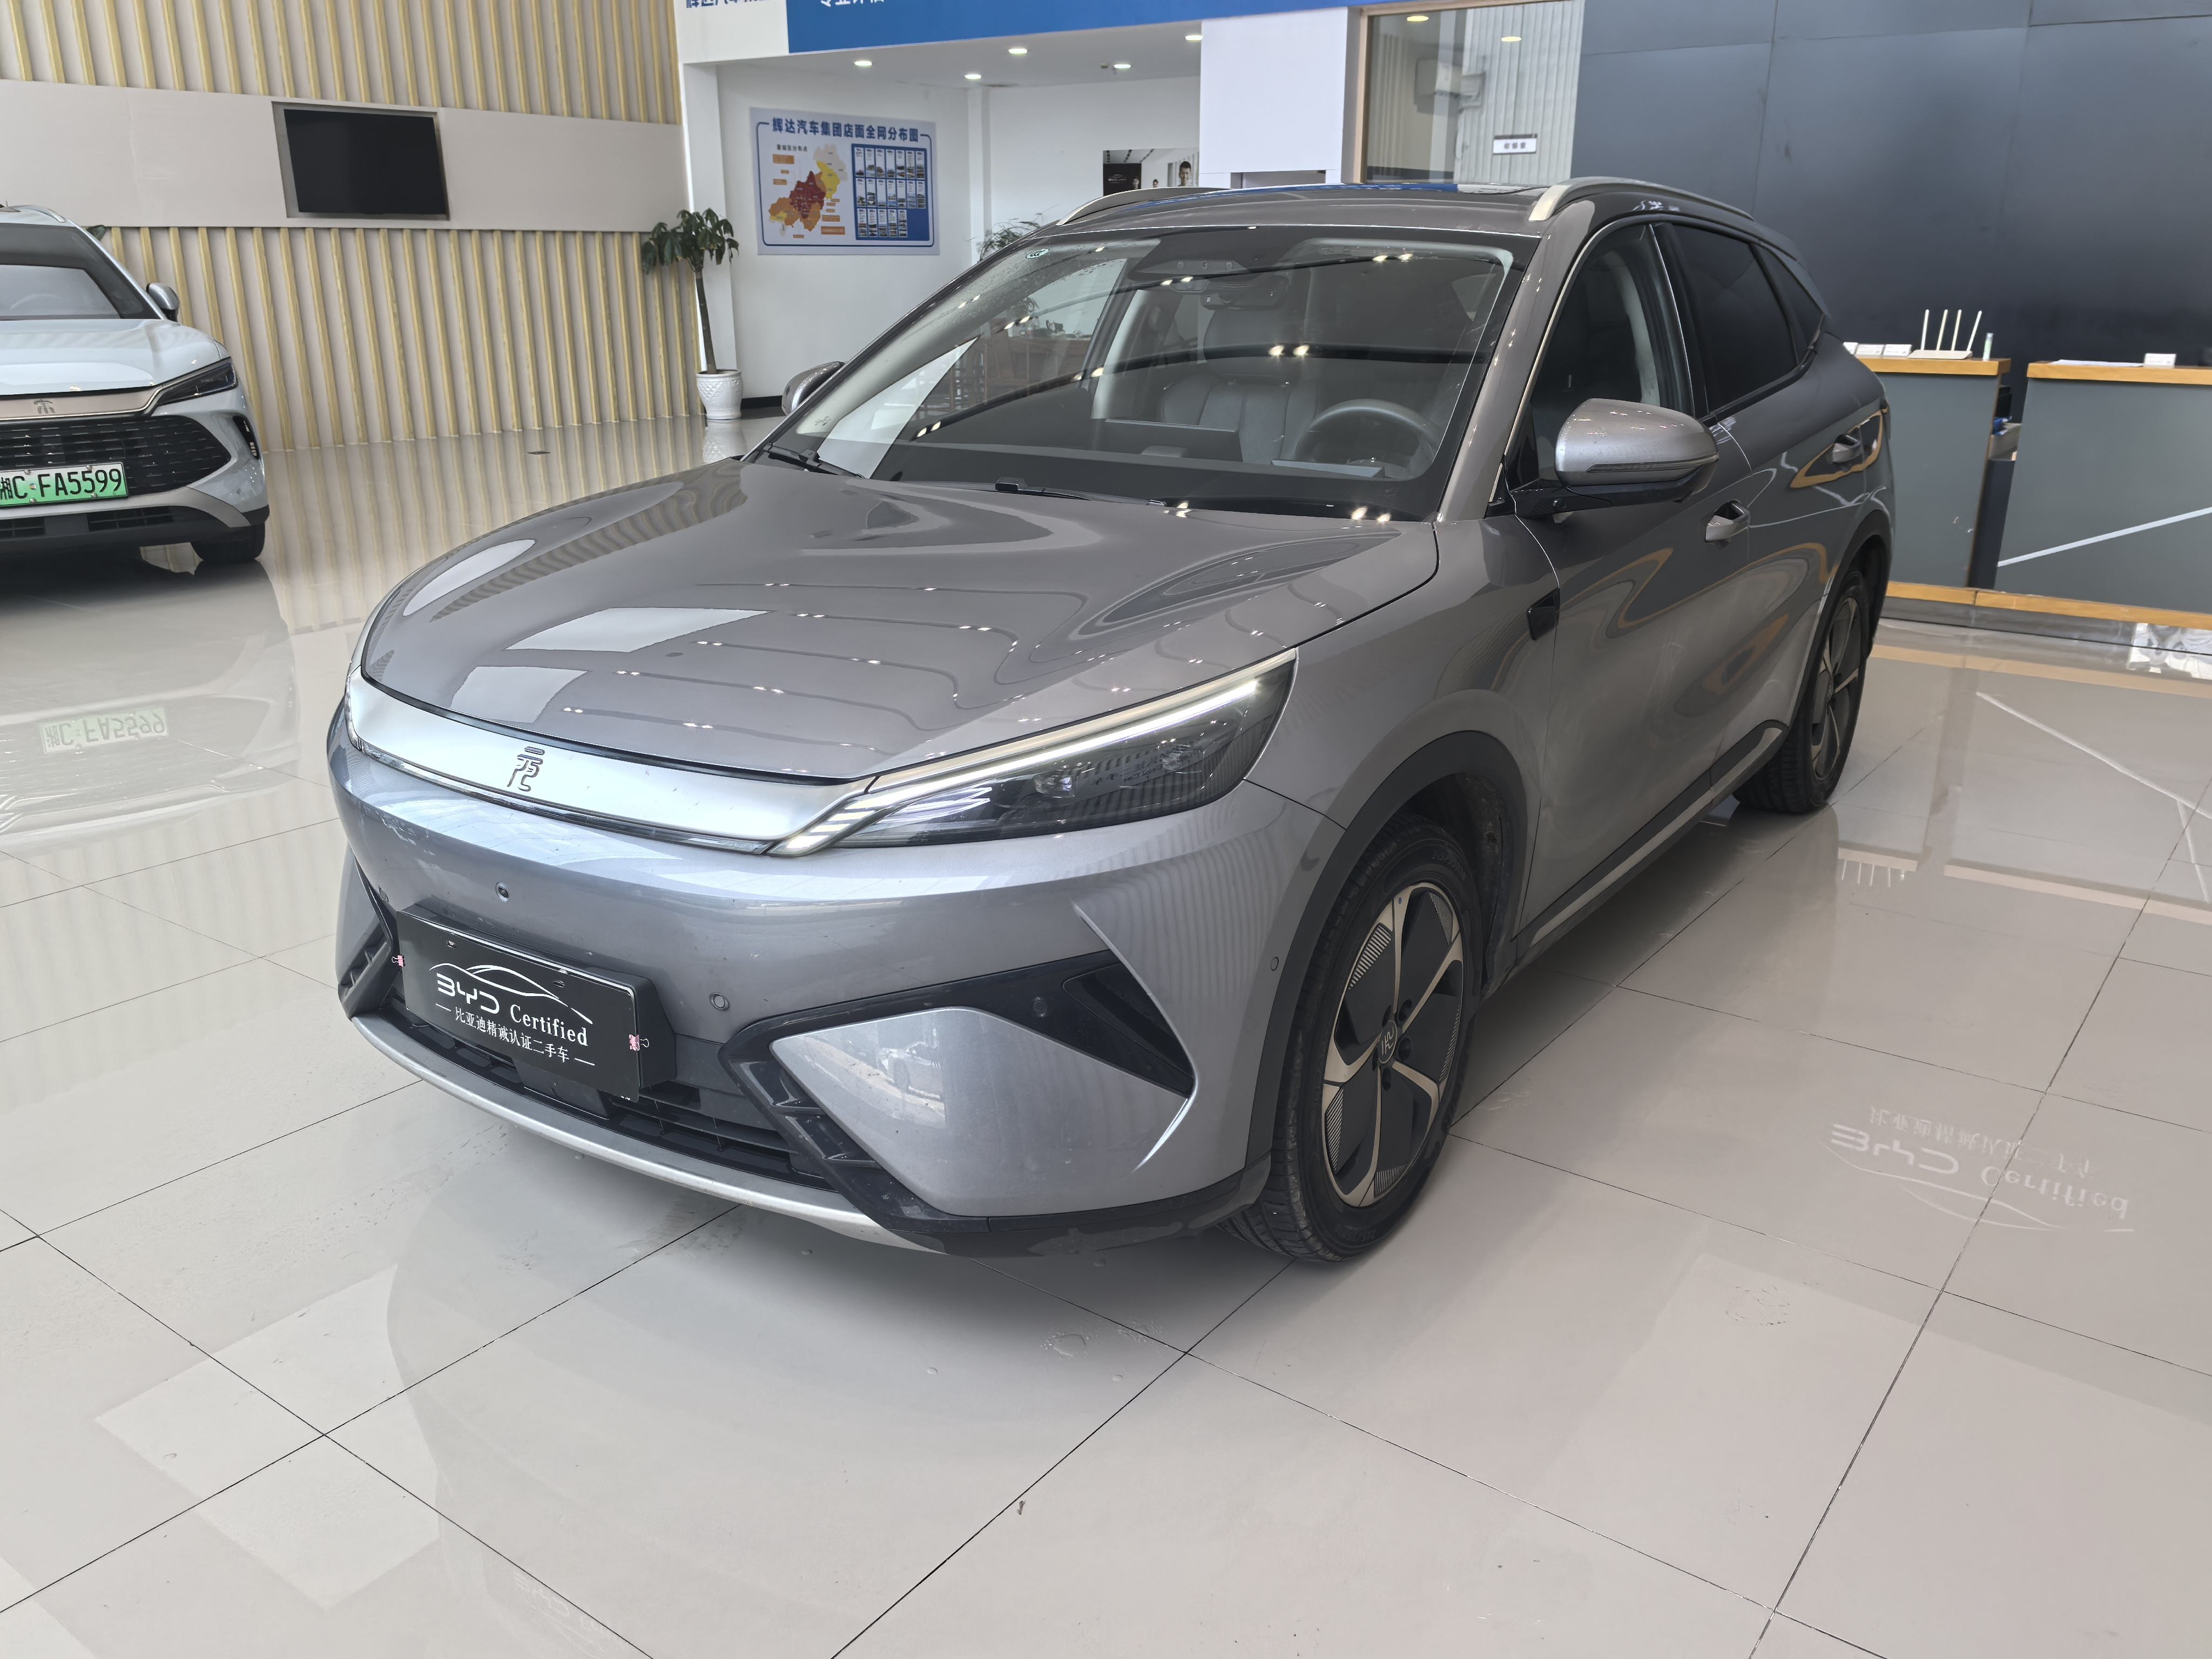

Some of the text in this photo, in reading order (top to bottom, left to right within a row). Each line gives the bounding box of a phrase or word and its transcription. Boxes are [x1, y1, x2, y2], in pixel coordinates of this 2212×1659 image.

[772, 117, 919, 142] 辉达汽车集团店面全网分布图
[436, 972, 588, 1047] BYD Certified
[455, 1007, 570, 1063] 比亚迪精诚认证二手车
